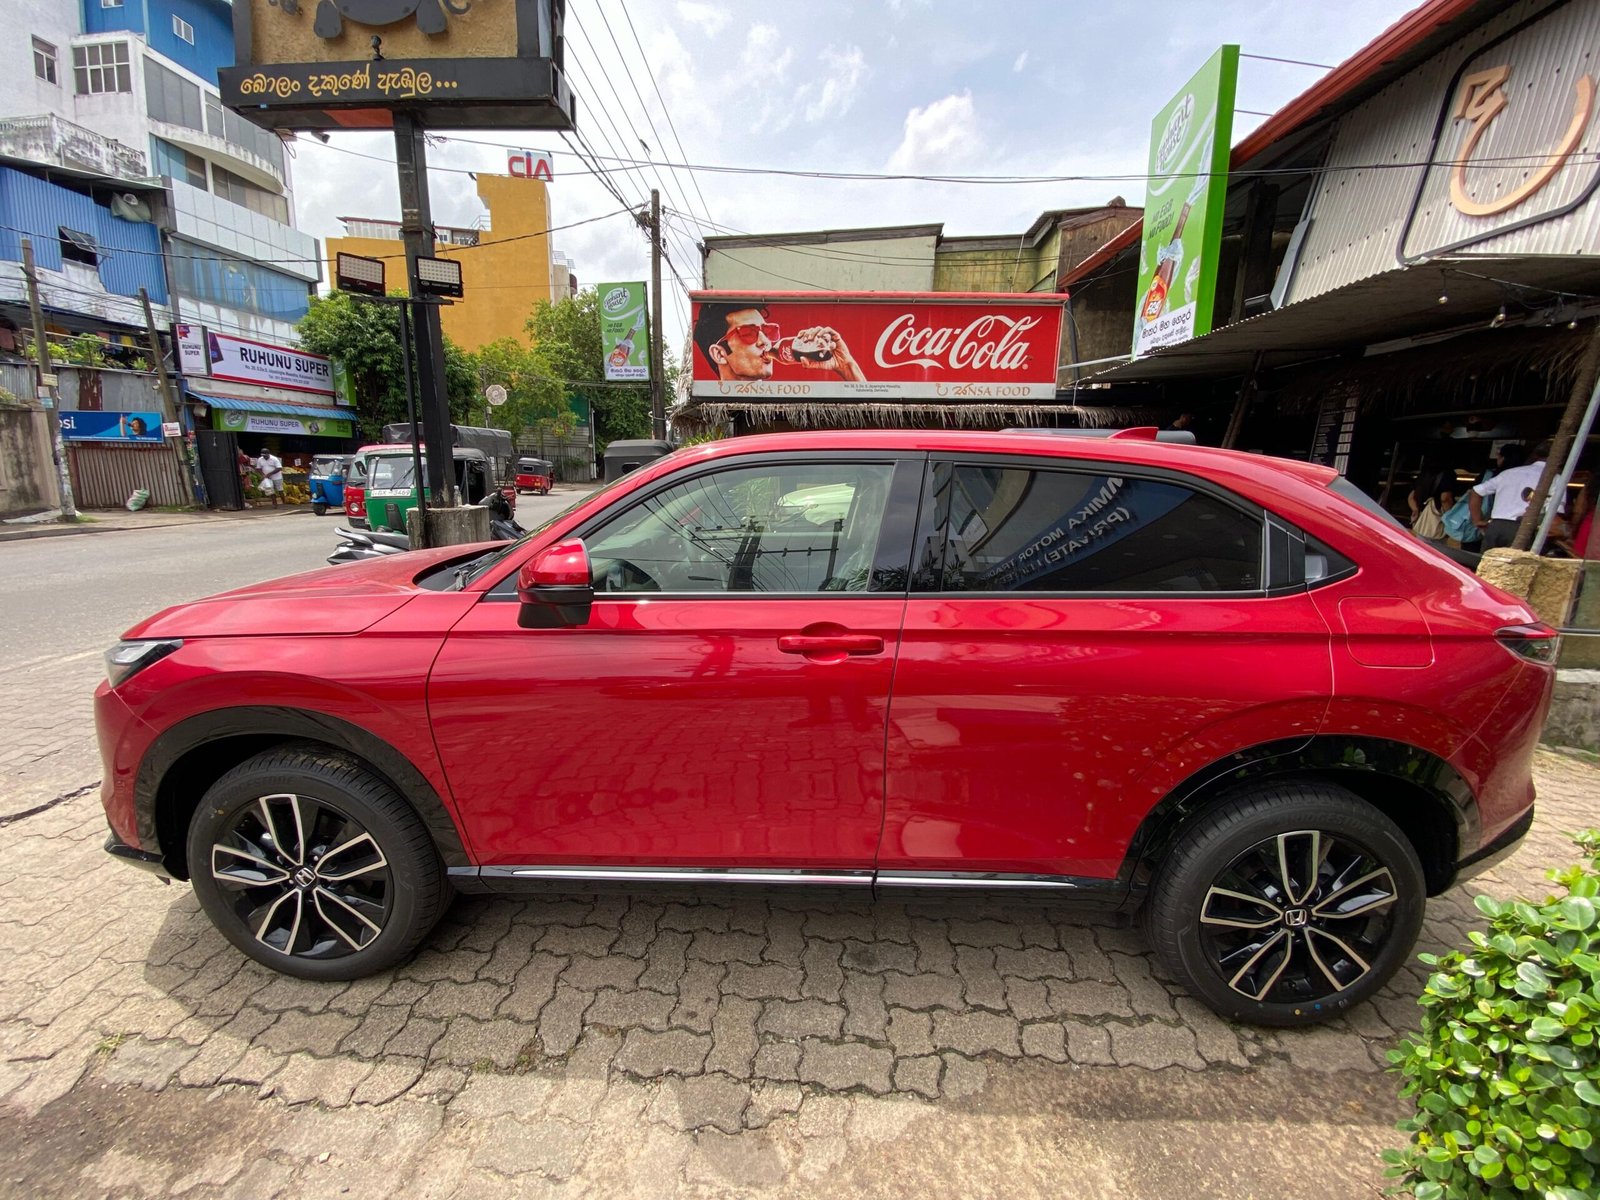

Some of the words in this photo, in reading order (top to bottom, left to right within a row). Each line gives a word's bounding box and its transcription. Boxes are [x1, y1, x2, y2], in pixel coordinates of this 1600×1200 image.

[239, 73, 301, 97] බොලං
[307, 63, 371, 97] දකුණේ
[874, 313, 1042, 370] Coca-Cola
[239, 347, 292, 370] RUHUNU
[295, 358, 330, 377] SUPER
[777, 384, 811, 395] FOOD
[996, 385, 1031, 396] FOOD
[250, 418, 278, 427] RUHUNU
[280, 420, 300, 428] SUPER
